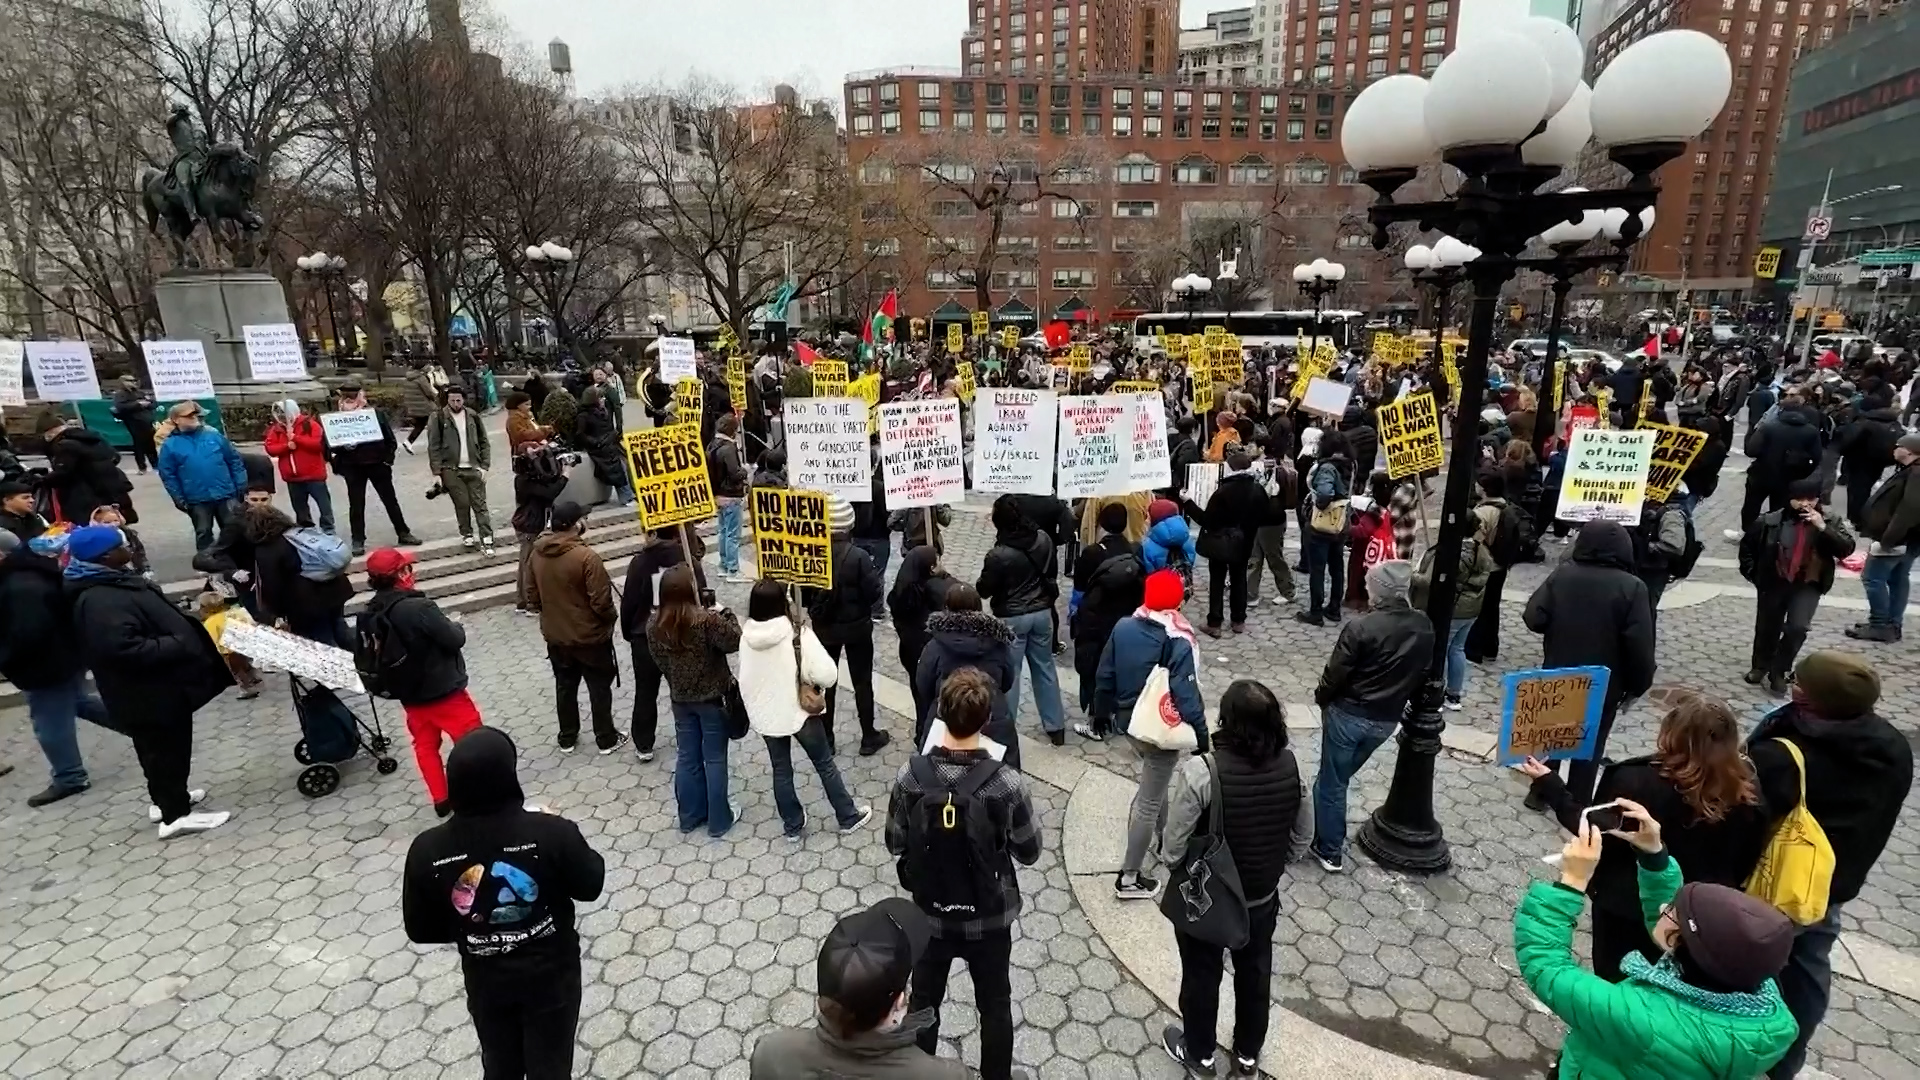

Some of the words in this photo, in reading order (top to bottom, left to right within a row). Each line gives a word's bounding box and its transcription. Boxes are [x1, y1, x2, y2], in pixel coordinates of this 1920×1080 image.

[1760, 253, 1778, 261] BEST
[1758, 264, 1773, 273] BUY
[814, 363, 832, 372] STOP
[814, 373, 847, 382] WAR
[994, 391, 1039, 404] DEFEND
[790, 403, 808, 415] NO
[813, 402, 828, 417] TO
[832, 403, 852, 417] THE
[882, 407, 902, 418] IRAN
[905, 405, 922, 414] HAS
[933, 403, 957, 412] RIGHT
[998, 409, 1026, 419] IRAN
[1064, 406, 1125, 418] INTERNATIONAL
[1381, 405, 1399, 426] NO
[1402, 395, 1432, 420] NEW
[786, 422, 838, 435] DEMOCRATIC
[843, 421, 869, 434] PARTY
[888, 418, 899, 430] TO
[901, 417, 909, 427] A
[916, 413, 955, 426] NUCLEAR
[987, 422, 1029, 432] AGAINST
[1384, 425, 1402, 440] US
[1403, 415, 1436, 434] WAR
[628, 430, 671, 442] MONEY
[885, 427, 940, 442] DETERRENT
[1074, 425, 1106, 436] ACTION
[903, 435, 948, 450] AGAINST
[994, 436, 1014, 446] THE
[1078, 434, 1117, 446] AGAINST
[1387, 441, 1404, 456] IN
[1405, 431, 1438, 450] THE
[1583, 433, 1612, 444] U.S.
[1618, 435, 1643, 444] Out
[1671, 431, 1703, 452] THE
[817, 440, 865, 454] GENOCIDE
[1585, 447, 1603, 456] of
[1607, 447, 1637, 460] Iraq
[632, 441, 702, 479] NEEDS
[803, 459, 820, 468] AND
[825, 457, 859, 469] RACIST
[913, 459, 935, 472] AND
[936, 456, 961, 470] ISRAEL
[1061, 458, 1078, 469] WAR
[1080, 456, 1095, 466] ON
[1099, 453, 1119, 465] IRAN
[1389, 449, 1419, 470] MIDDLE
[1420, 443, 1439, 460] EAST
[1650, 447, 1693, 466] AR
[990, 464, 1013, 473] WAR
[1578, 460, 1590, 470] &
[1594, 461, 1639, 474] Syria!
[640, 481, 669, 493] NOT
[673, 473, 705, 486] WAR
[798, 472, 817, 484] COP
[823, 469, 865, 484] TERROR!
[1573, 477, 1615, 490] Hands
[1618, 481, 1637, 490] Off
[642, 491, 667, 514] W/
[672, 483, 709, 508] IRAN
[1582, 490, 1624, 504] IRAN!
[756, 491, 781, 514] NO
[785, 495, 824, 520] NEW
[758, 516, 784, 532] US
[785, 519, 827, 538] WAR
[760, 538, 784, 552] IN
[785, 541, 828, 558] THE
[761, 553, 800, 572] MIDDLE
[802, 559, 828, 576] EAST
[1516, 679, 1566, 698] STOP
[1569, 677, 1600, 691] THE
[1520, 693, 1565, 713] WAR
[1510, 726, 1592, 748] DEMOCRACY
[1542, 740, 1577, 753] NOW
